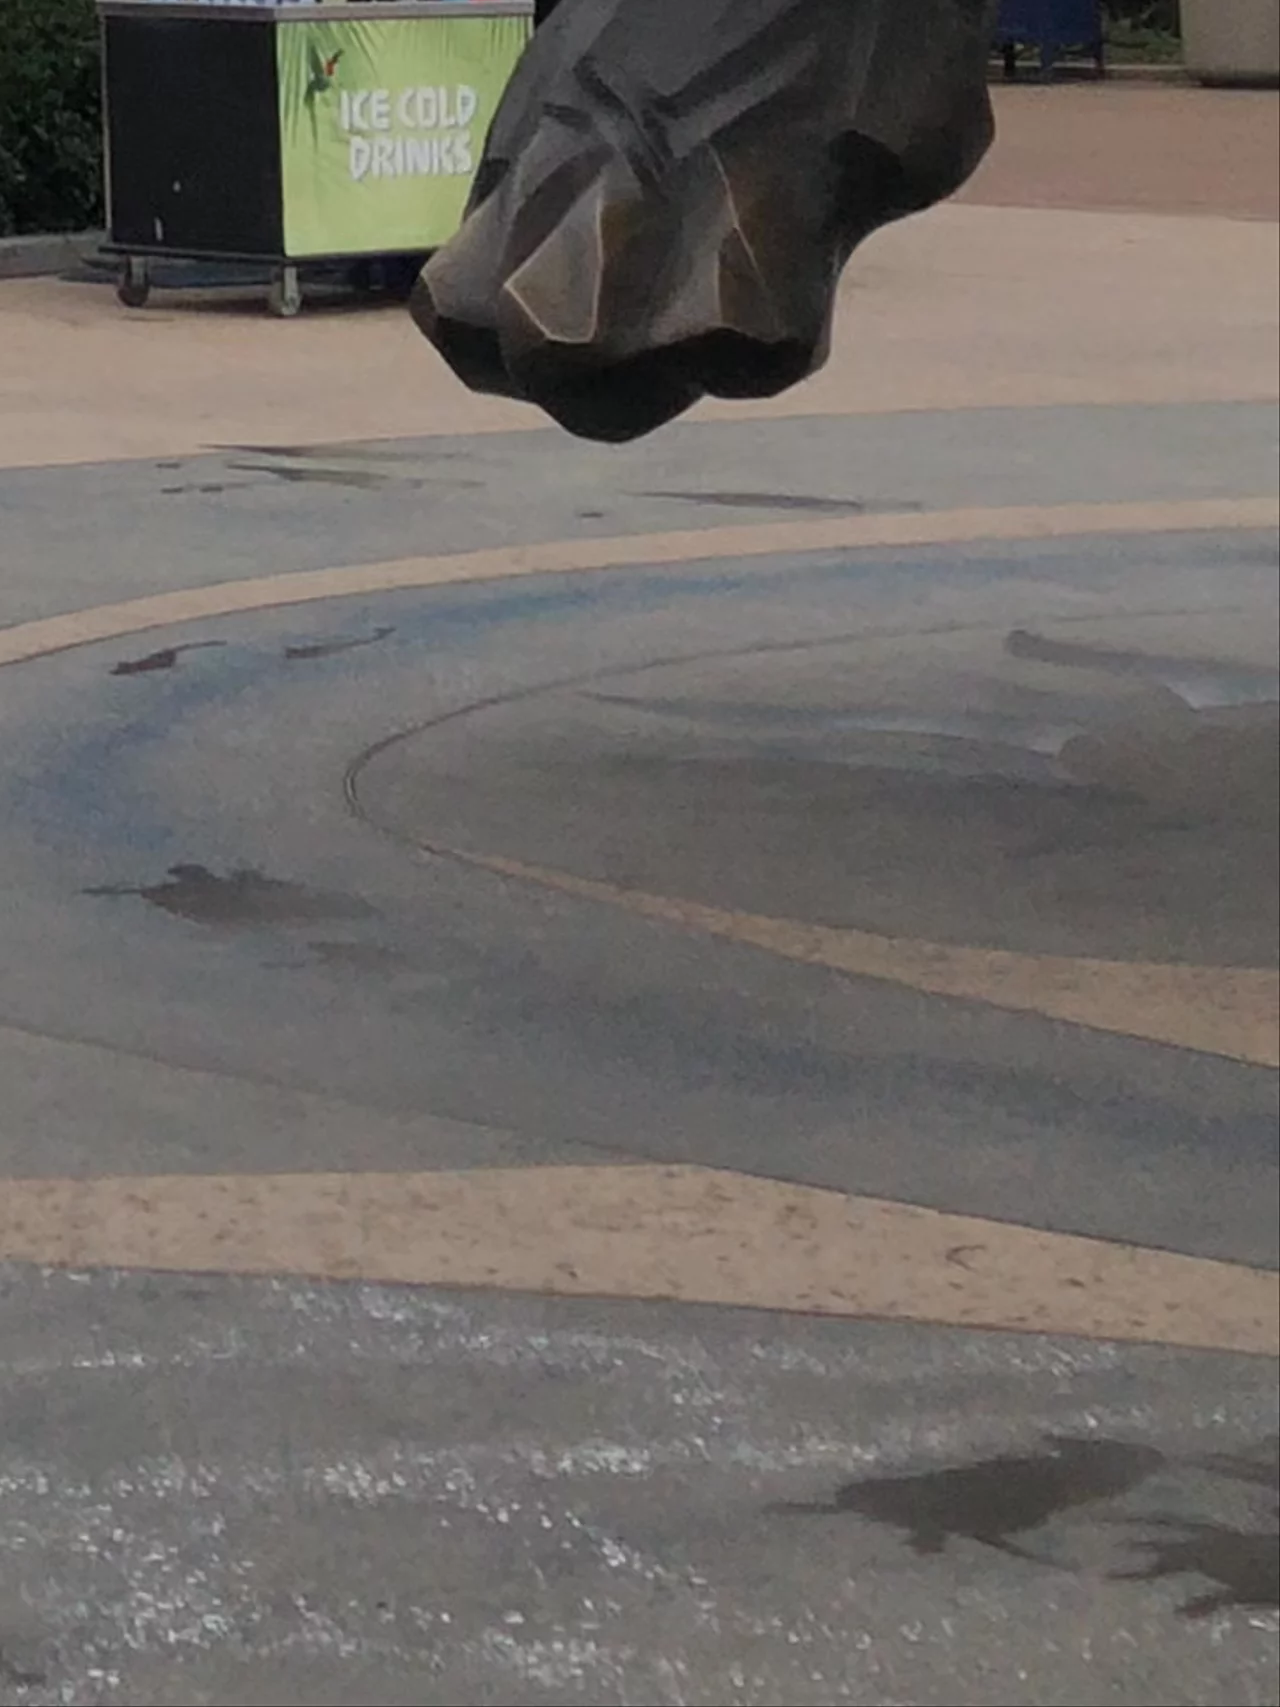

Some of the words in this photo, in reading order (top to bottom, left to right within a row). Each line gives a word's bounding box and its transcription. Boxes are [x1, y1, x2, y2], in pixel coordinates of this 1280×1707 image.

[341, 88, 391, 131] ICE
[395, 84, 478, 130] COLD
[349, 129, 474, 182] DRINKS
